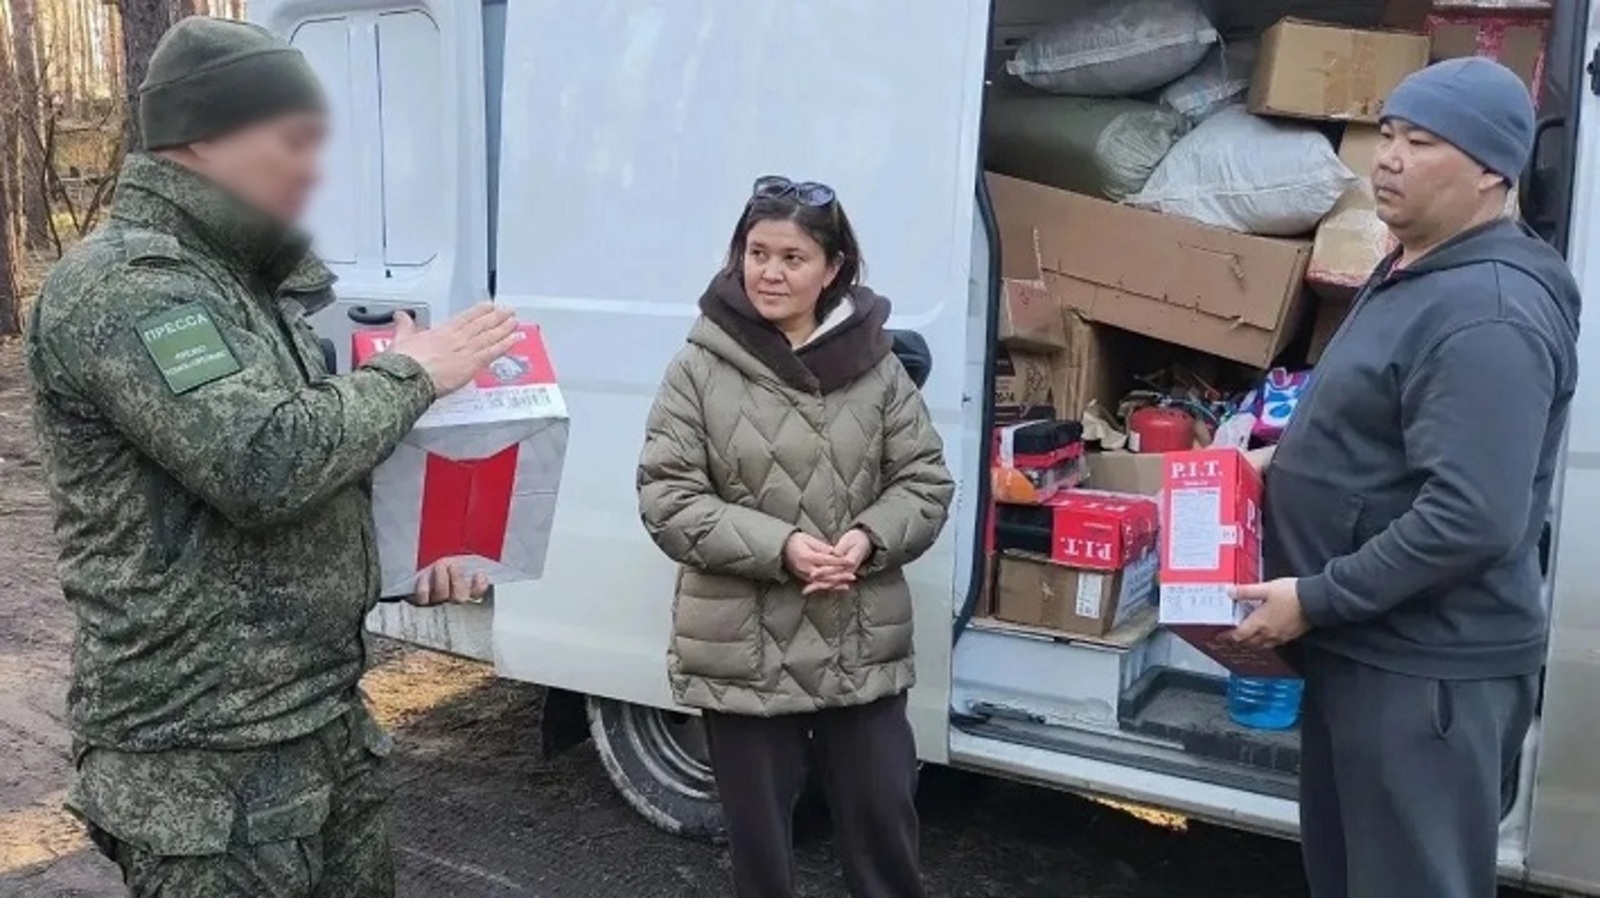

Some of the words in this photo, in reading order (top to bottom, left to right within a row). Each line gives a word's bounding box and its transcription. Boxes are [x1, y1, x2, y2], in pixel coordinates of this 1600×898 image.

[144, 313, 208, 342] ПРЕССА
[1171, 460, 1224, 479] P.I.T.
[1059, 536, 1113, 560] P.I.T.
